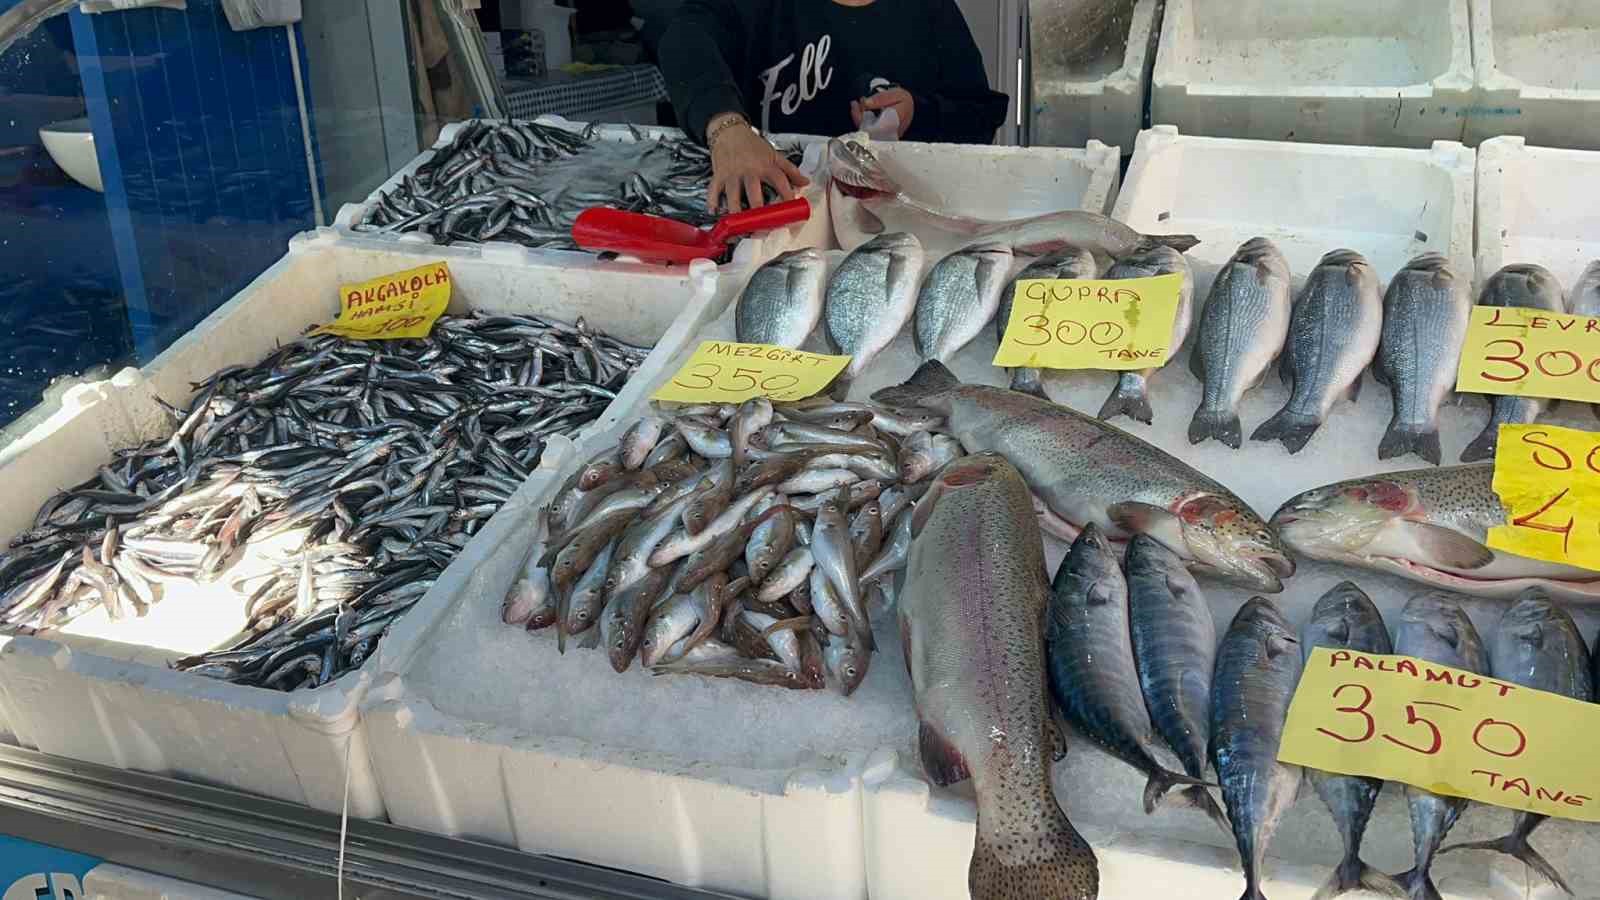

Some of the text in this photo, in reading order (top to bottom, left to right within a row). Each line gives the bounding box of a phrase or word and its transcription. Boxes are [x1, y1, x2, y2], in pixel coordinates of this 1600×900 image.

[758, 34, 833, 132] Fell
[1013, 314, 1124, 346] 300
[1099, 348, 1169, 359] TANE
[673, 363, 800, 392] 350
[1330, 651, 1516, 697] PALAMUT
[1316, 684, 1527, 757] 350
[1471, 769, 1593, 807] TANE
